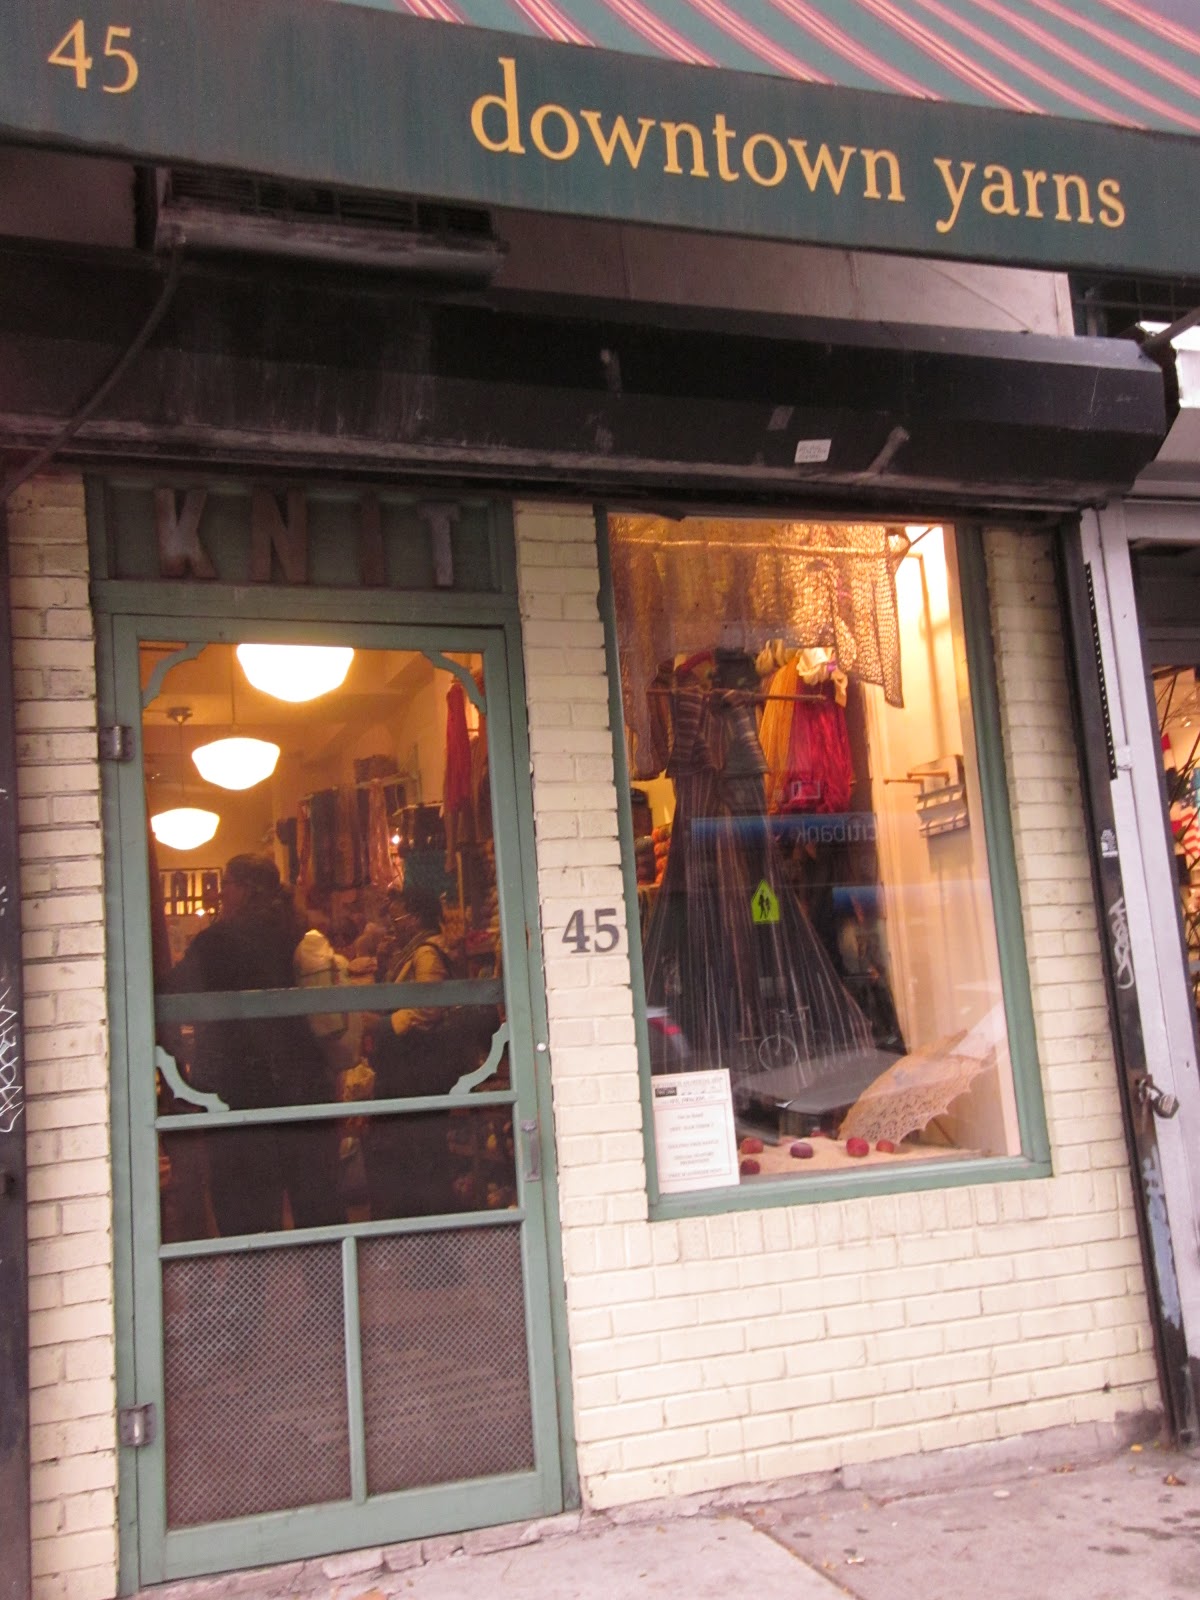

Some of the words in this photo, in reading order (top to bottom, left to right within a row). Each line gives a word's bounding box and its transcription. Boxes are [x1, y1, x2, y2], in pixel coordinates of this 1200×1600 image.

[48, 19, 139, 93] 45
[470, 57, 906, 202] downtown
[933, 157, 1126, 234] yarns
[154, 486, 460, 588] KNIT
[561, 908, 620, 954] 45
